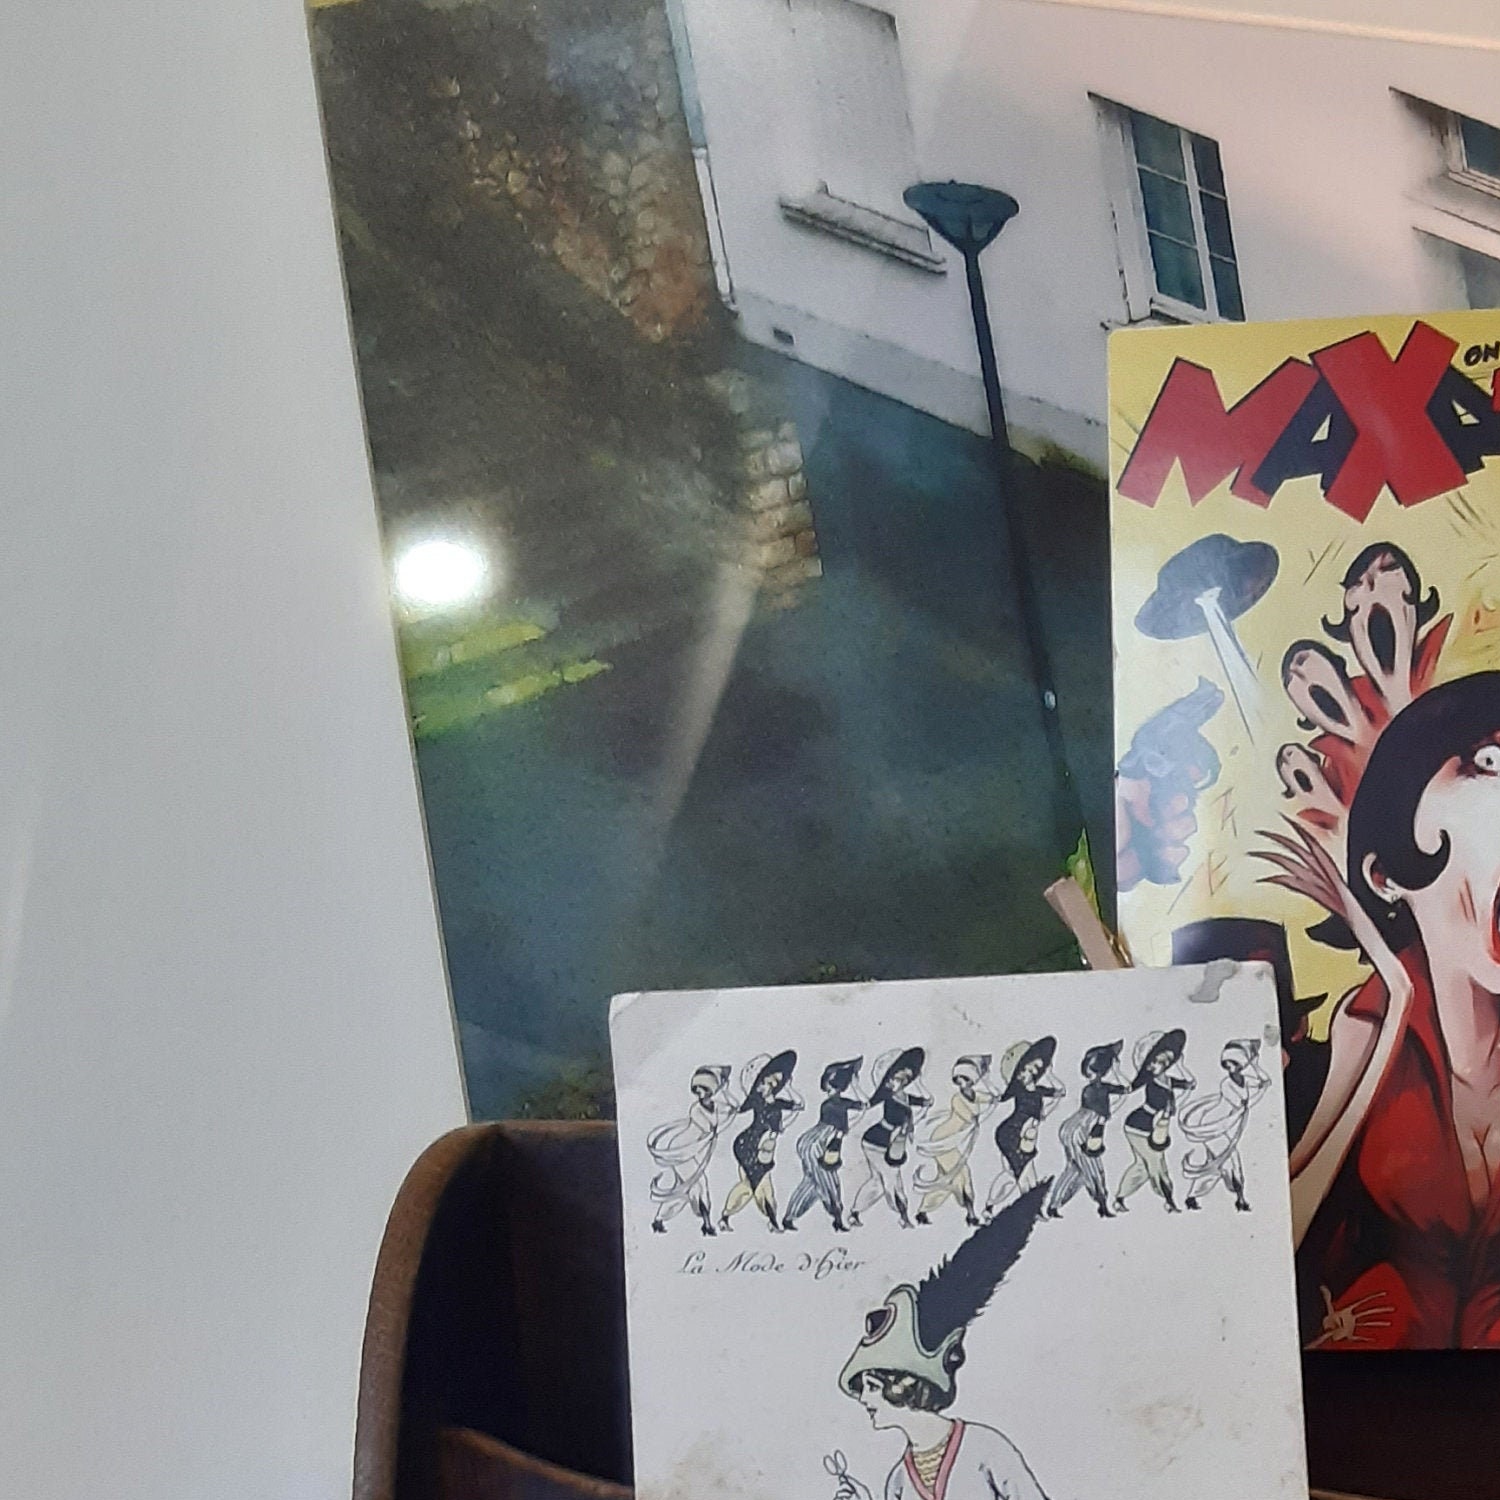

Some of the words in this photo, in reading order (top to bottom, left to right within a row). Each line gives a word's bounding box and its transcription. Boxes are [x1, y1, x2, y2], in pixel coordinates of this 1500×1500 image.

[1463, 340, 1500, 367] ON
[676, 1250, 706, 1275] La
[716, 1249, 785, 1273] Mode
